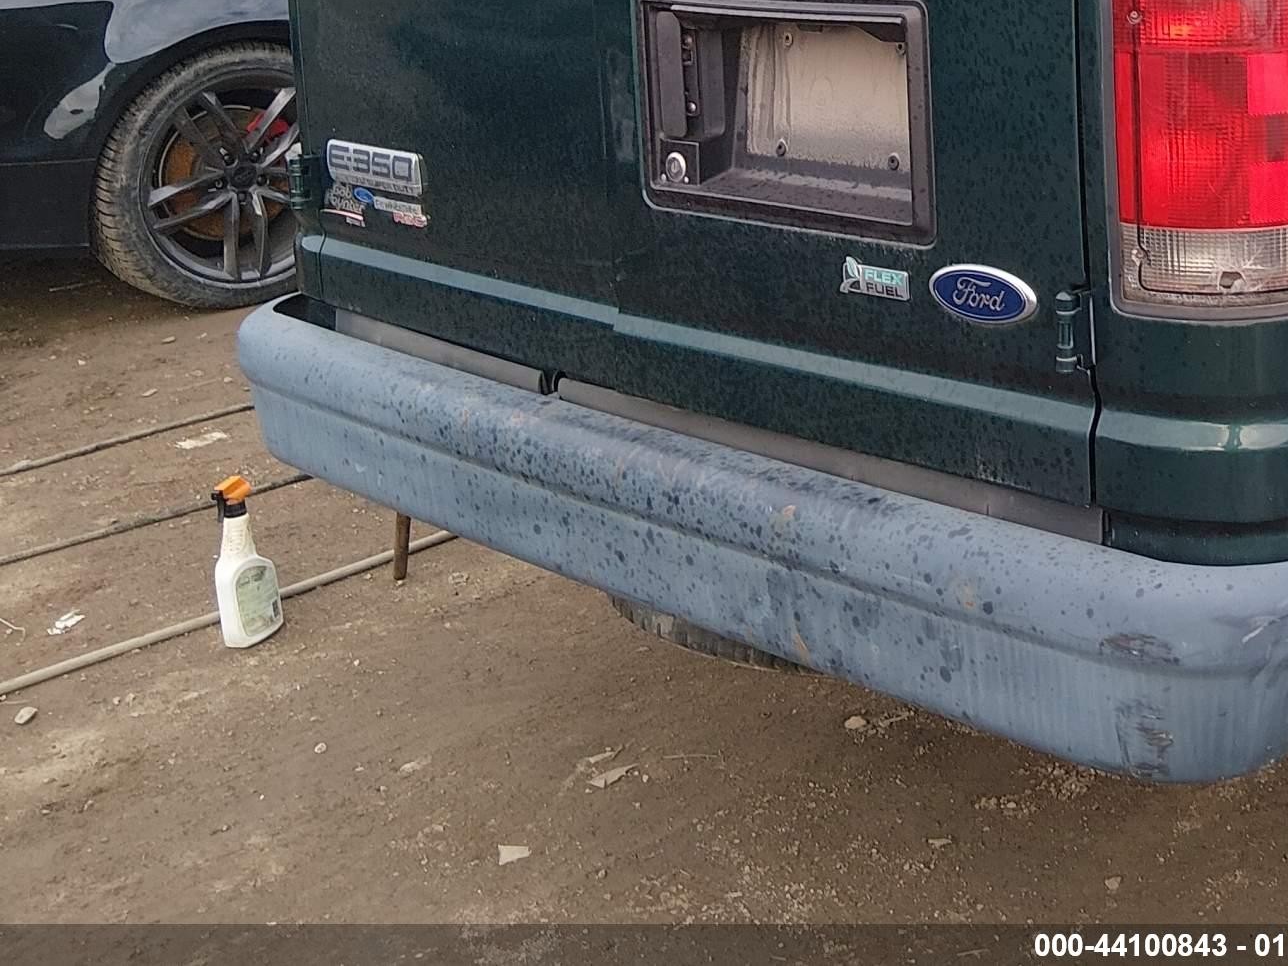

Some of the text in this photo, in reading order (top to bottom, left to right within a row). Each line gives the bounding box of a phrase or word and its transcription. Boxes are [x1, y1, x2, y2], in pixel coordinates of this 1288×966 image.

[328, 143, 413, 183] E-350
[864, 269, 903, 285] FLEX
[865, 283, 904, 299] FUEL
[952, 276, 1005, 312] Ford
